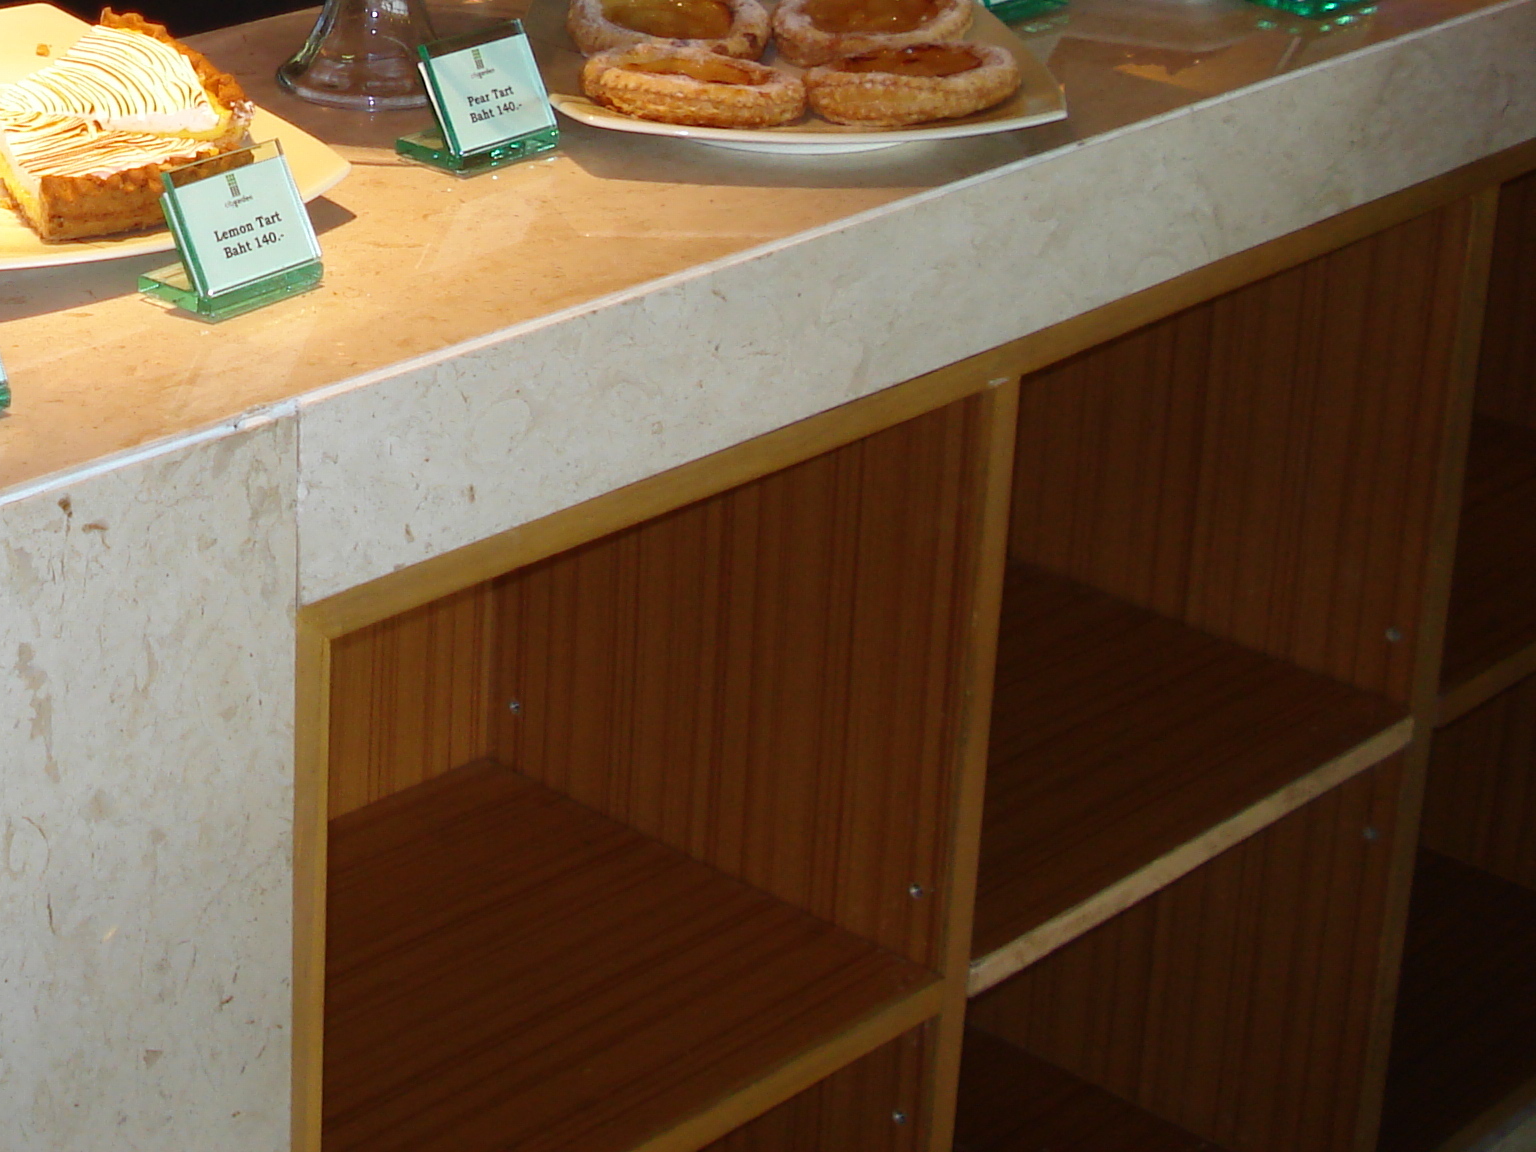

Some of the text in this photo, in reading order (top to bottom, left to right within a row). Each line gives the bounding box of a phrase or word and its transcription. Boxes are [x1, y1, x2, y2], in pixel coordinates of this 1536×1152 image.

[467, 85, 514, 107] Pear Tart
[469, 101, 522, 124] Baht 140.-
[213, 211, 282, 243] Lemon Tart
[223, 231, 285, 259] Baht 140.-
